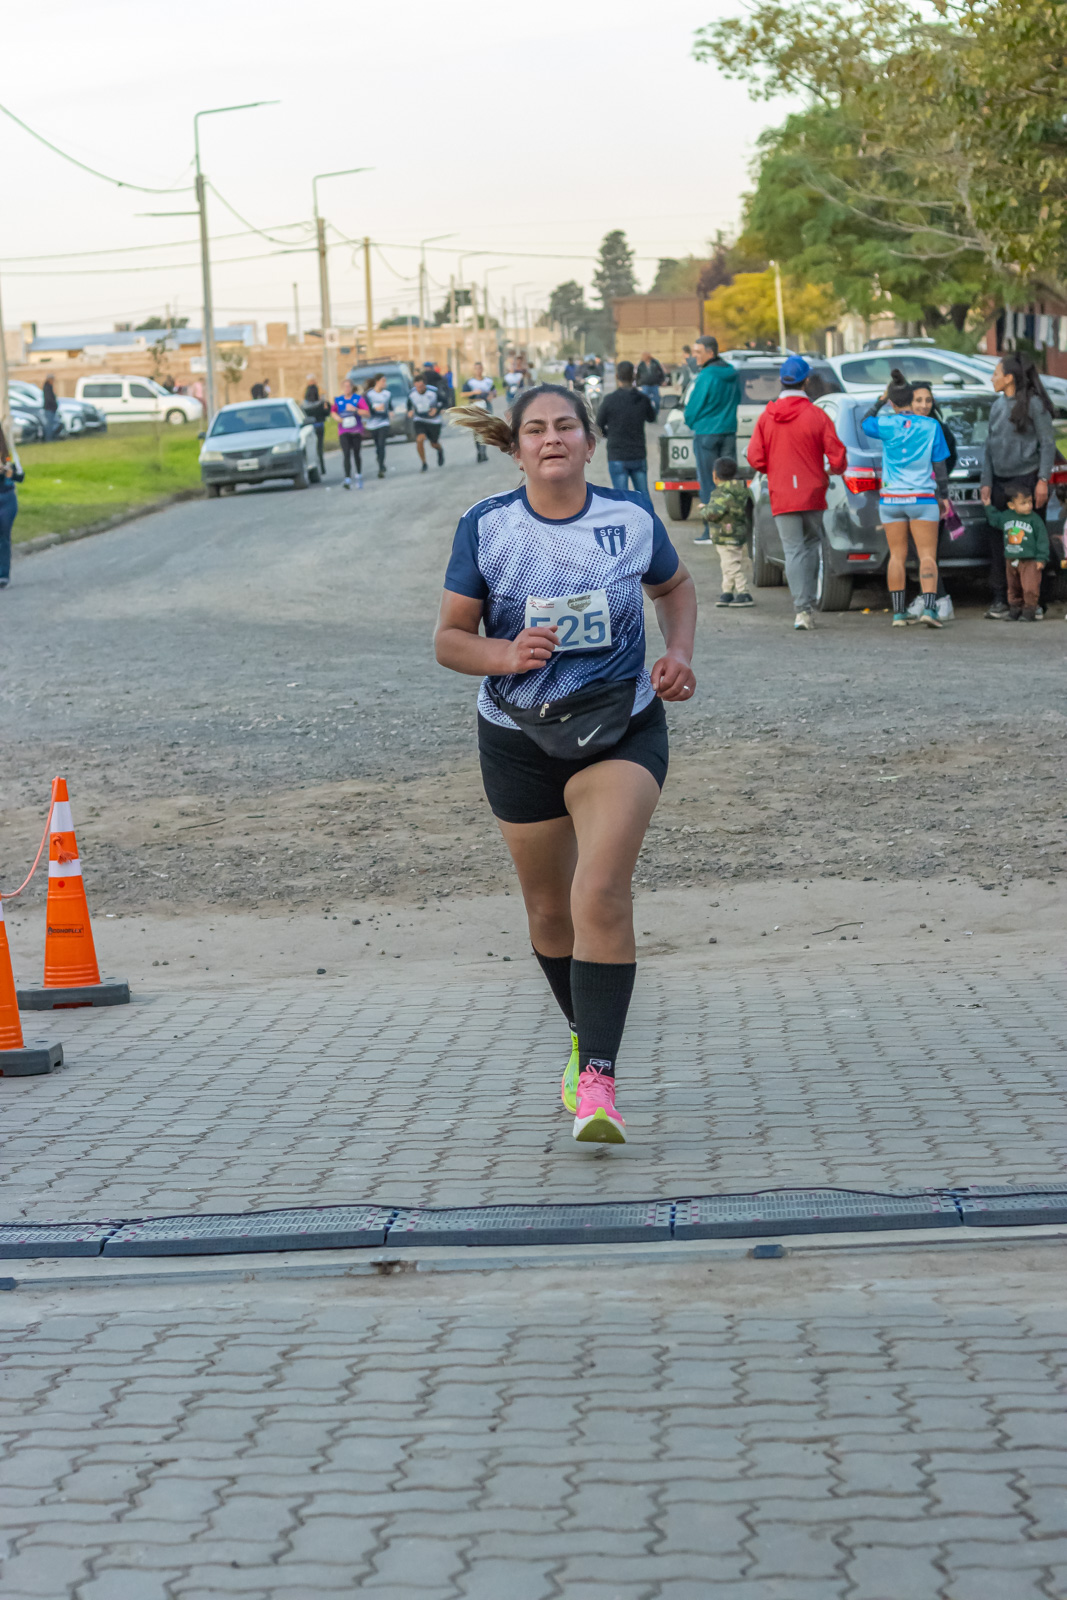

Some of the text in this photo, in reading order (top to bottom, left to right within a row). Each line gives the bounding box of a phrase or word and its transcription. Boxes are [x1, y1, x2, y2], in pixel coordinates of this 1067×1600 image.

[672, 446, 689, 460] 80
[948, 489, 966, 500] PKT
[600, 528, 621, 537] SFC
